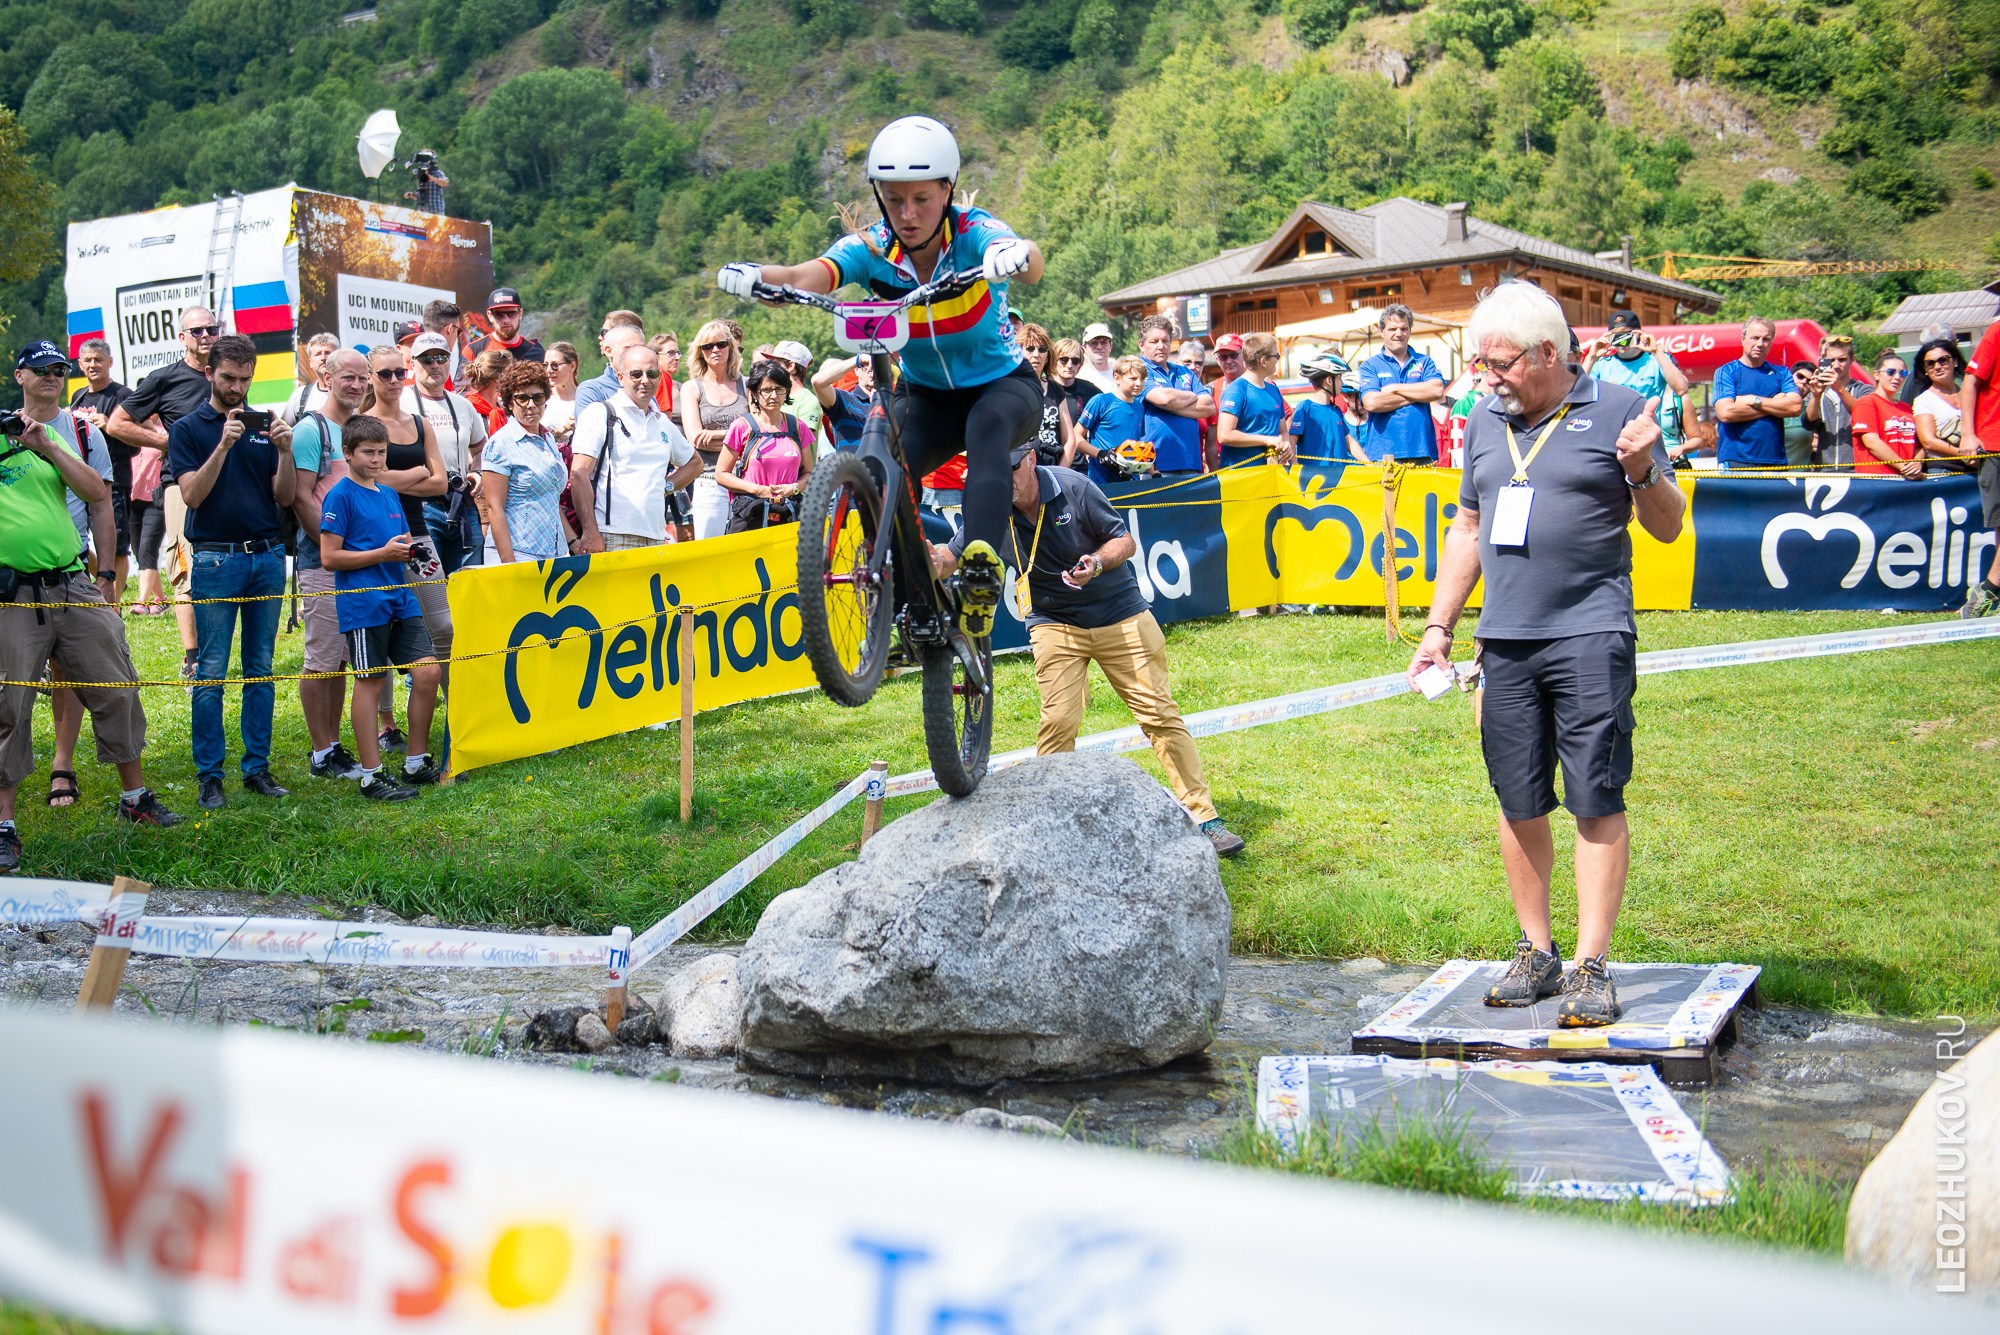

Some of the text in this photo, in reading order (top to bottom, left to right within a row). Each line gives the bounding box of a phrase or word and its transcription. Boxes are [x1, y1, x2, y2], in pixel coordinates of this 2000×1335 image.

[124, 295, 137, 308] UCI
[139, 288, 181, 305] MOUNTAIN
[348, 293, 424, 317] UCI MOUNTAIN
[125, 307, 183, 346] WOR
[349, 316, 389, 333] WORLD
[864, 317, 878, 338] 6
[132, 349, 189, 369] CHAMPIONS
[80, 1090, 252, 1284] Val
